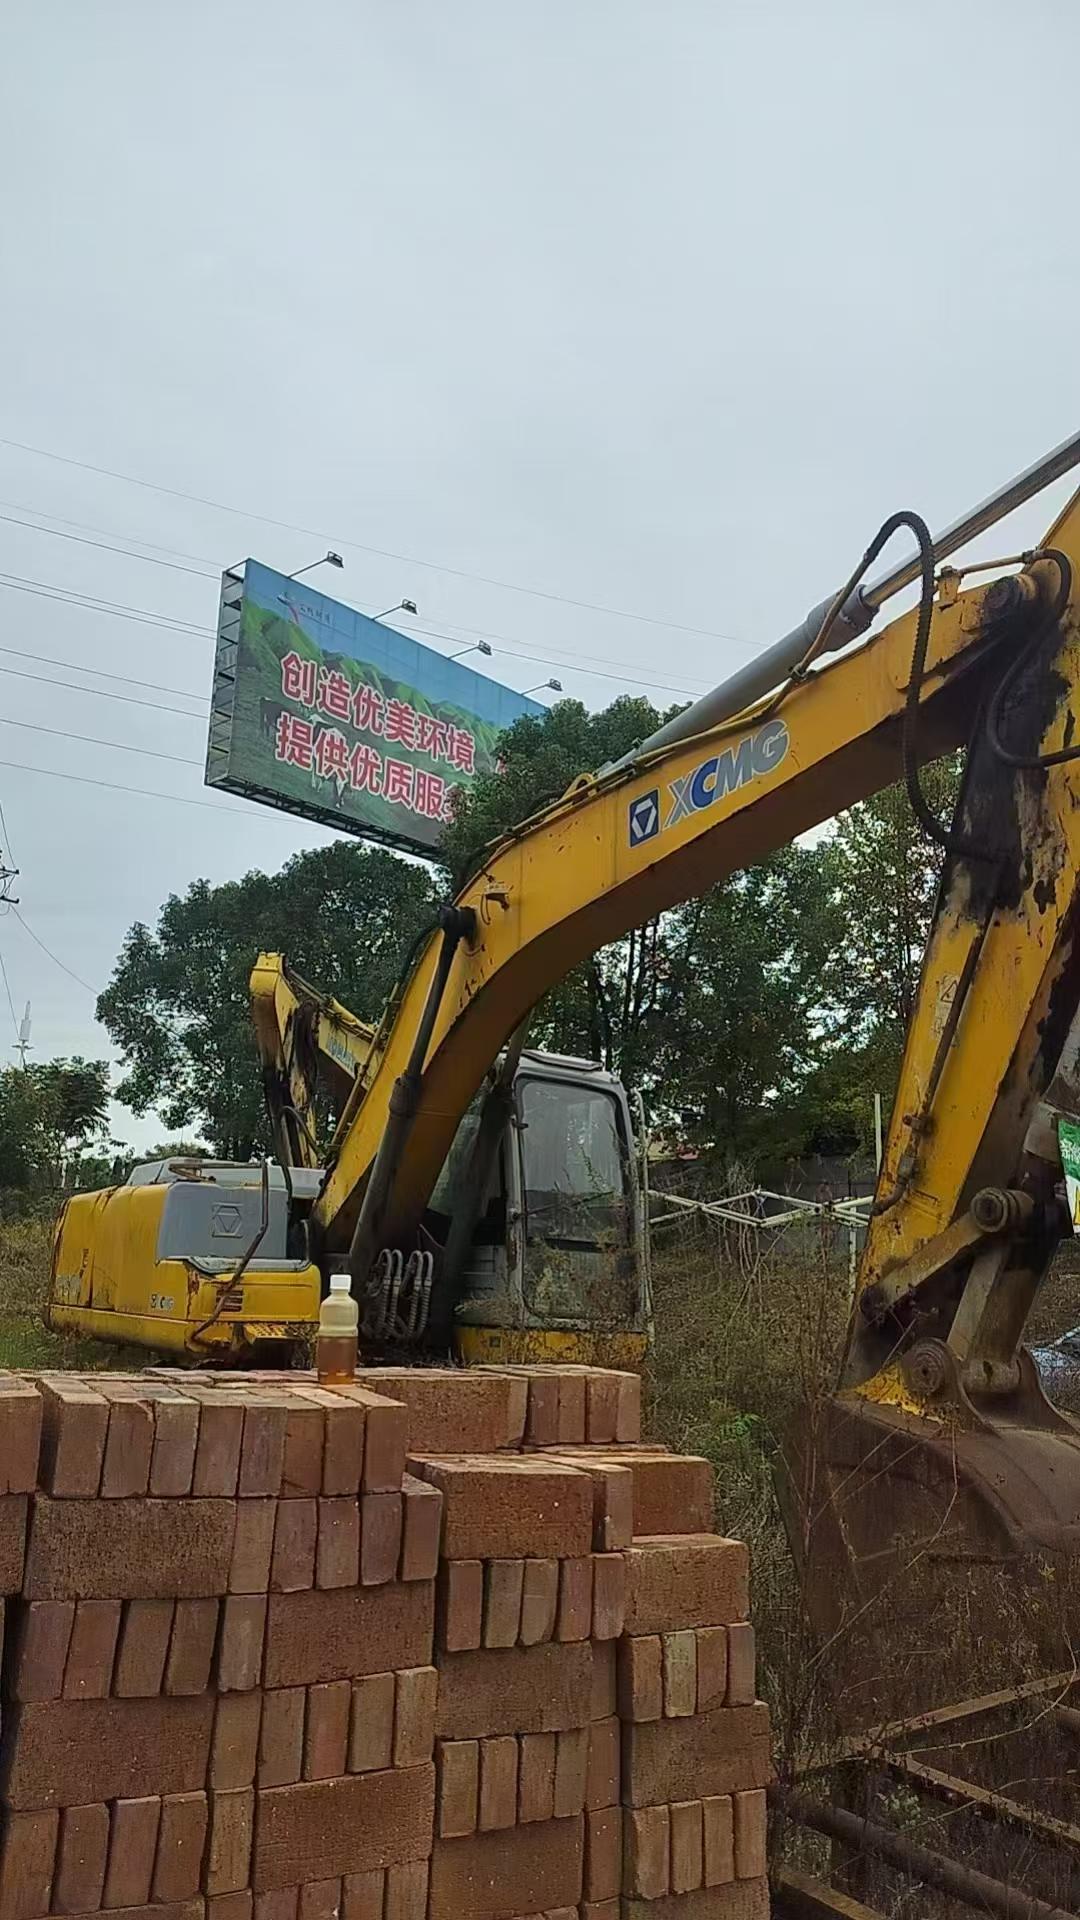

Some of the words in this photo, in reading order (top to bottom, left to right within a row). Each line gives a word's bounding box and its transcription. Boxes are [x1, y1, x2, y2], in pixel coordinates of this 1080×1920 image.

[281, 652, 475, 776] 创造优美环境
[662, 719, 790, 831] XCMG
